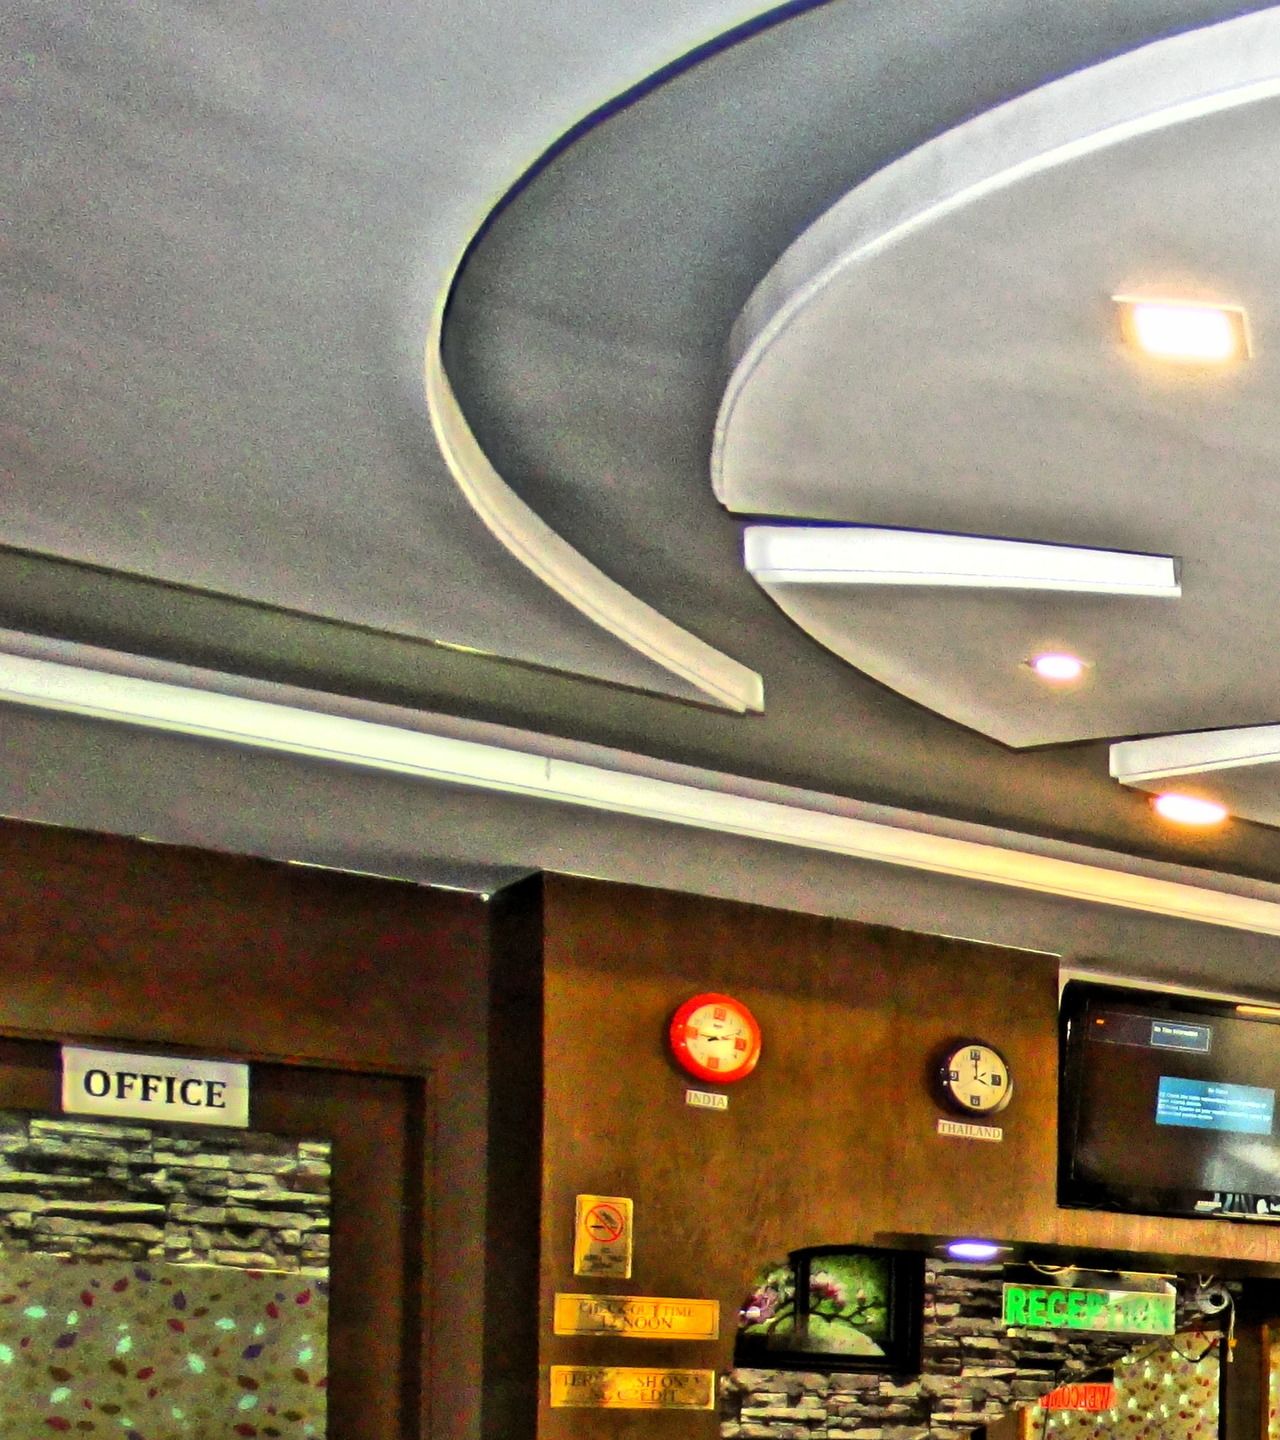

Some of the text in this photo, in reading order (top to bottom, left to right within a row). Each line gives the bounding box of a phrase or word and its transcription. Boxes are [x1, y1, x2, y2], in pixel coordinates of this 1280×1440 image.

[83, 1068, 227, 1108] OFFICE
[688, 1092, 725, 1107] INDIA
[941, 1123, 1001, 1138] THAILAND
[664, 1303, 695, 1317] TIME
[622, 1316, 674, 1330] NOON
